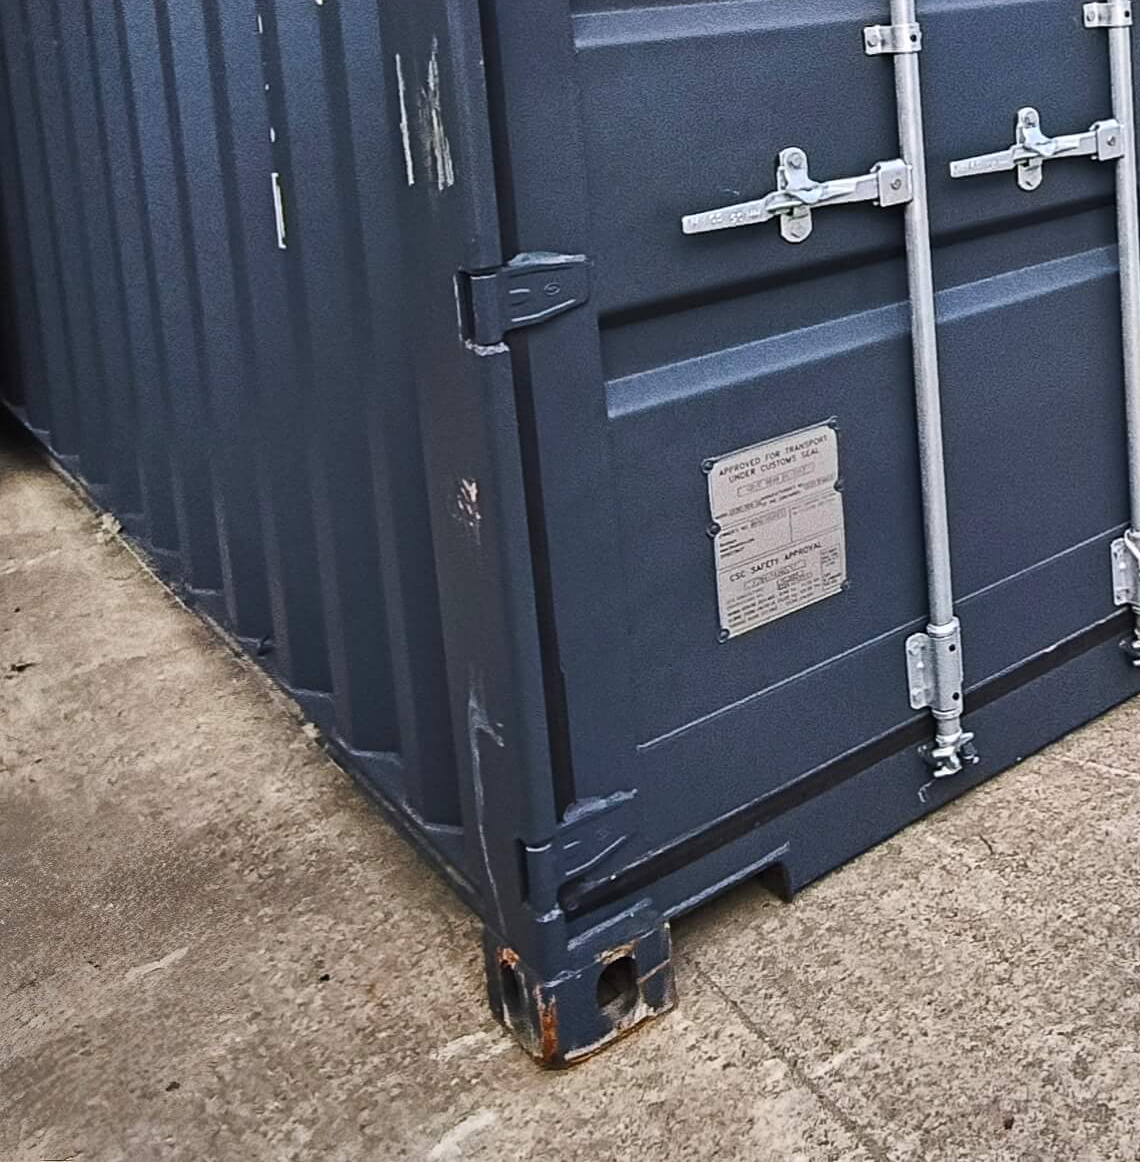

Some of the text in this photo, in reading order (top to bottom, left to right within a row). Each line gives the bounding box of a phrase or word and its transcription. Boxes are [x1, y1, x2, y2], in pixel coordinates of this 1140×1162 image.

[719, 434, 829, 476] APPROVED FOR TRANSPORT
[728, 468, 756, 484] UNDER
[760, 455, 797, 473] CUSTOMS
[801, 447, 820, 462] SEAL
[729, 571, 747, 583] CSC
[751, 557, 780, 574] SAFETY
[784, 541, 823, 561] APPROVAL
